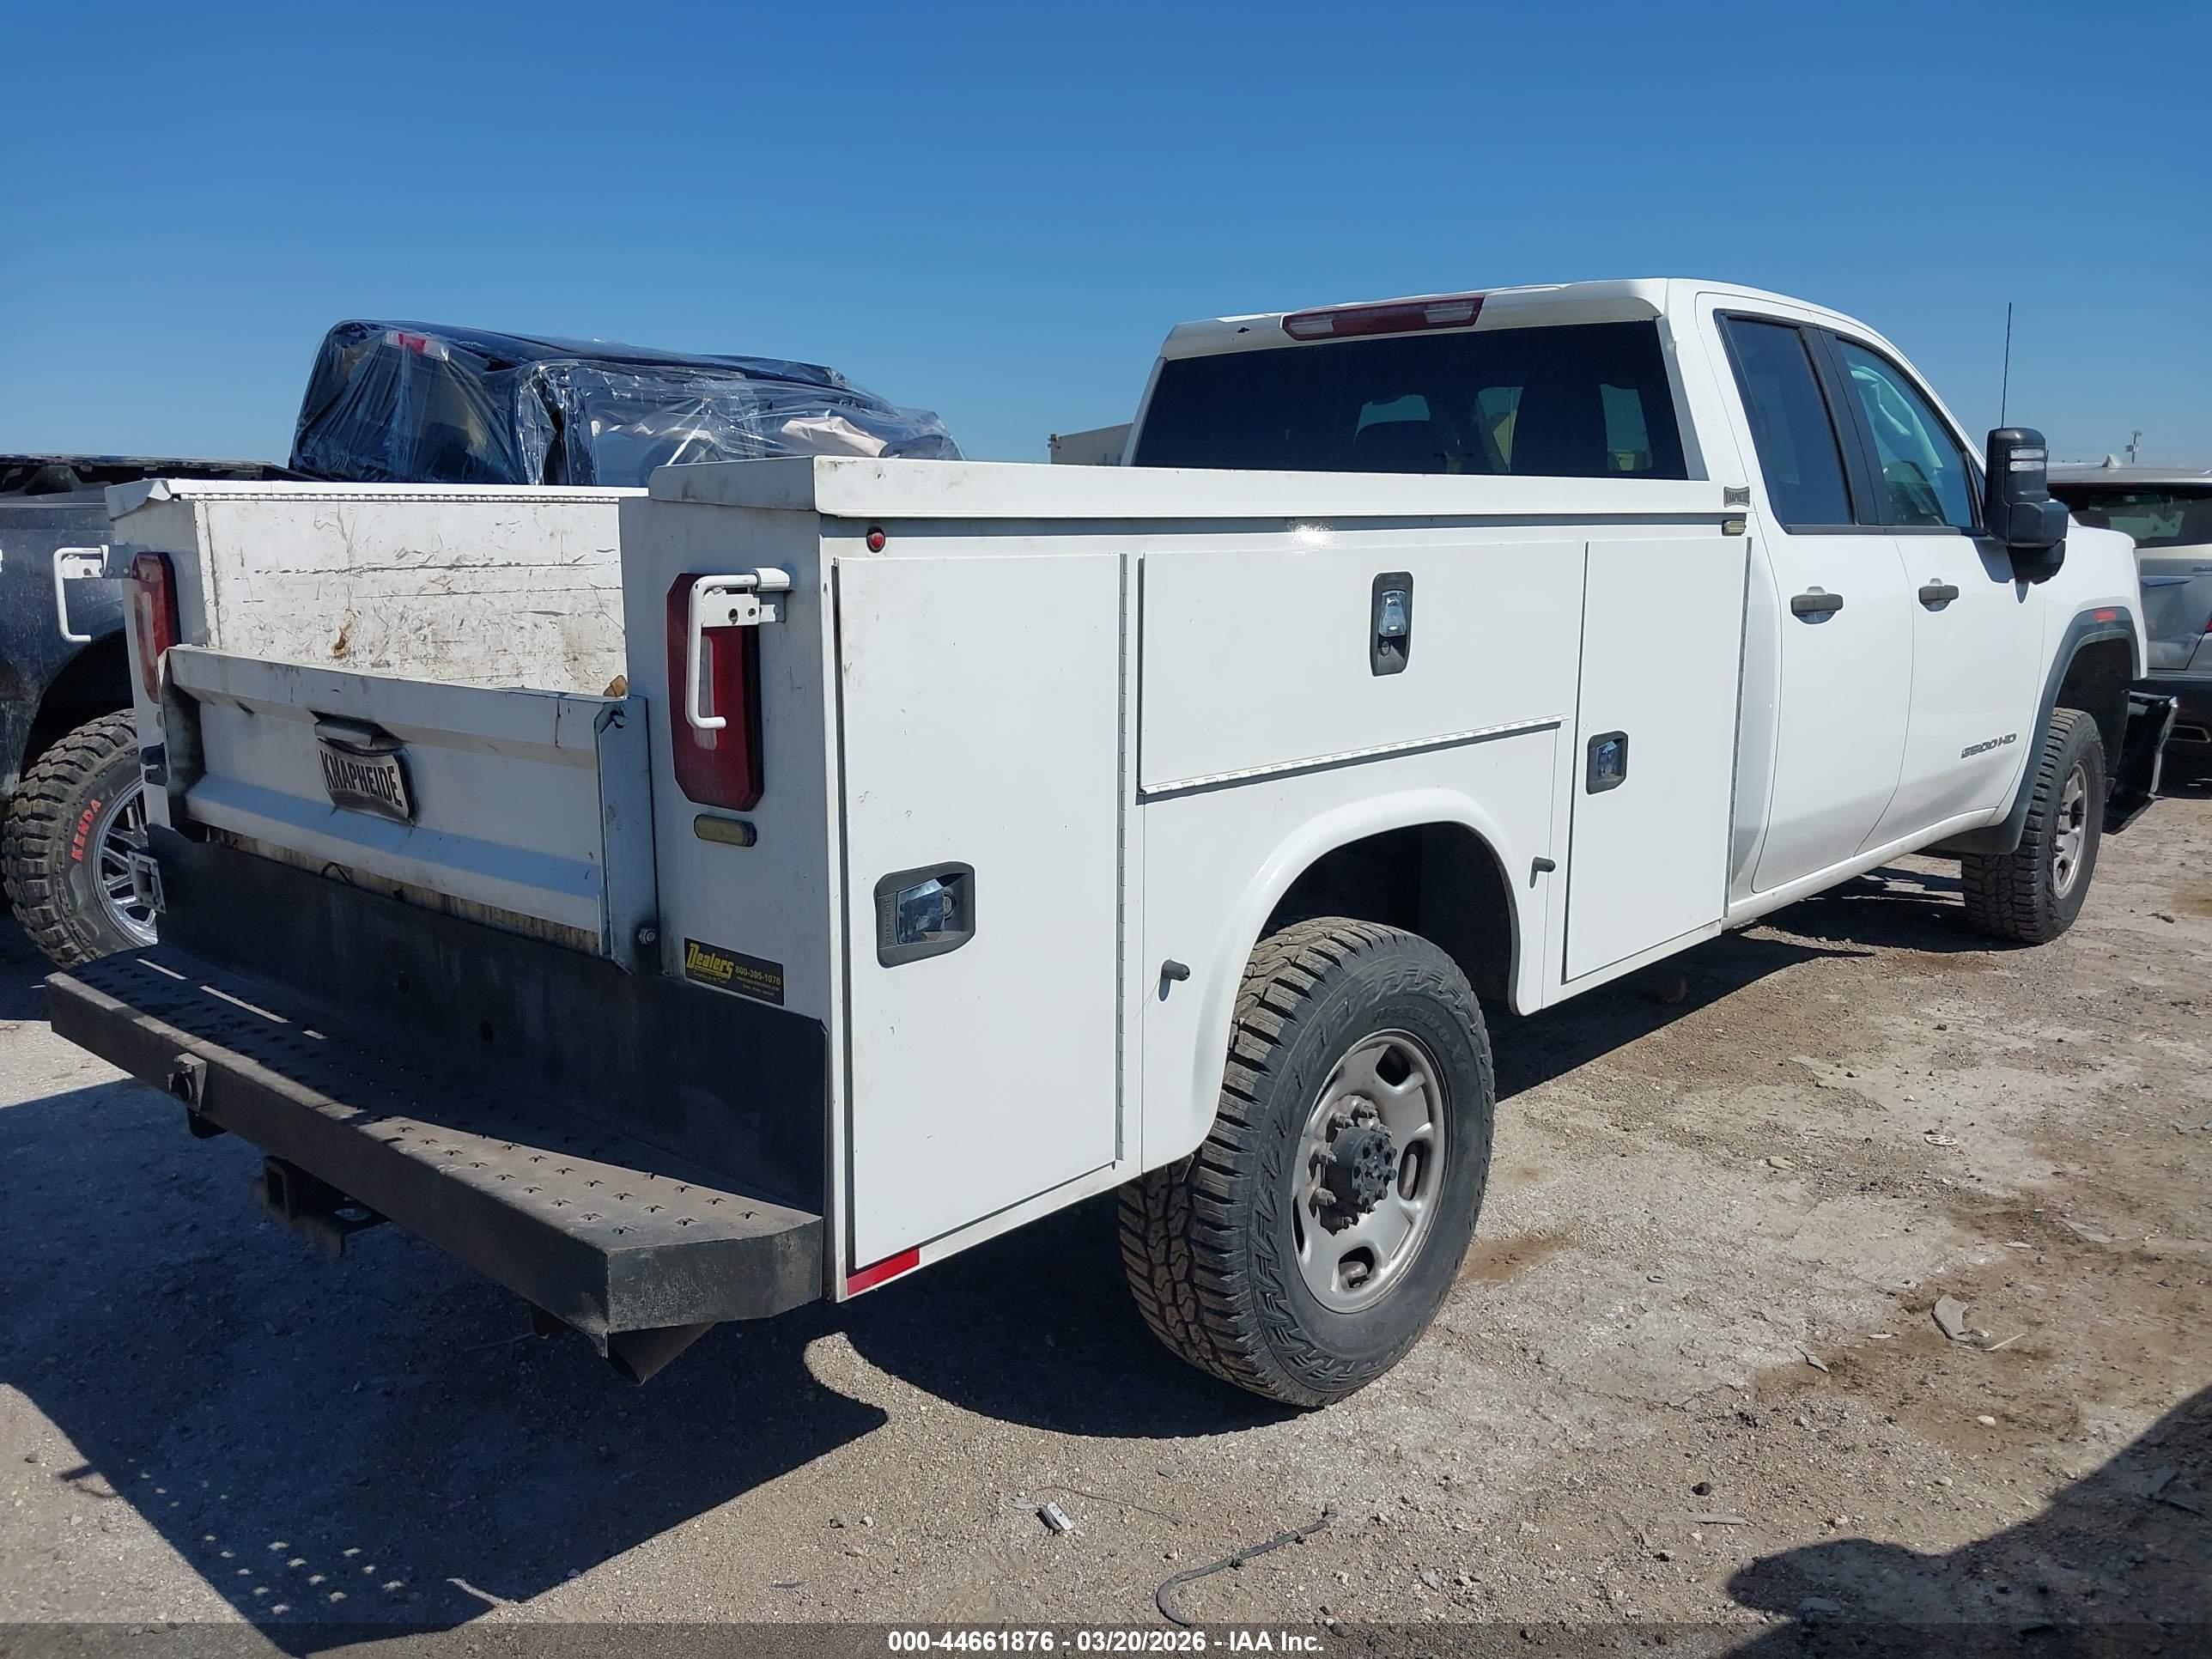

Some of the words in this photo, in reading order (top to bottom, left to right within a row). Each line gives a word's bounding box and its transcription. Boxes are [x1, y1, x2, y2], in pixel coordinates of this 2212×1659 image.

[319, 750, 403, 807] KNAPHEIDE
[70, 799, 102, 862] KENDA
[735, 965, 781, 986] 800-305-1070
